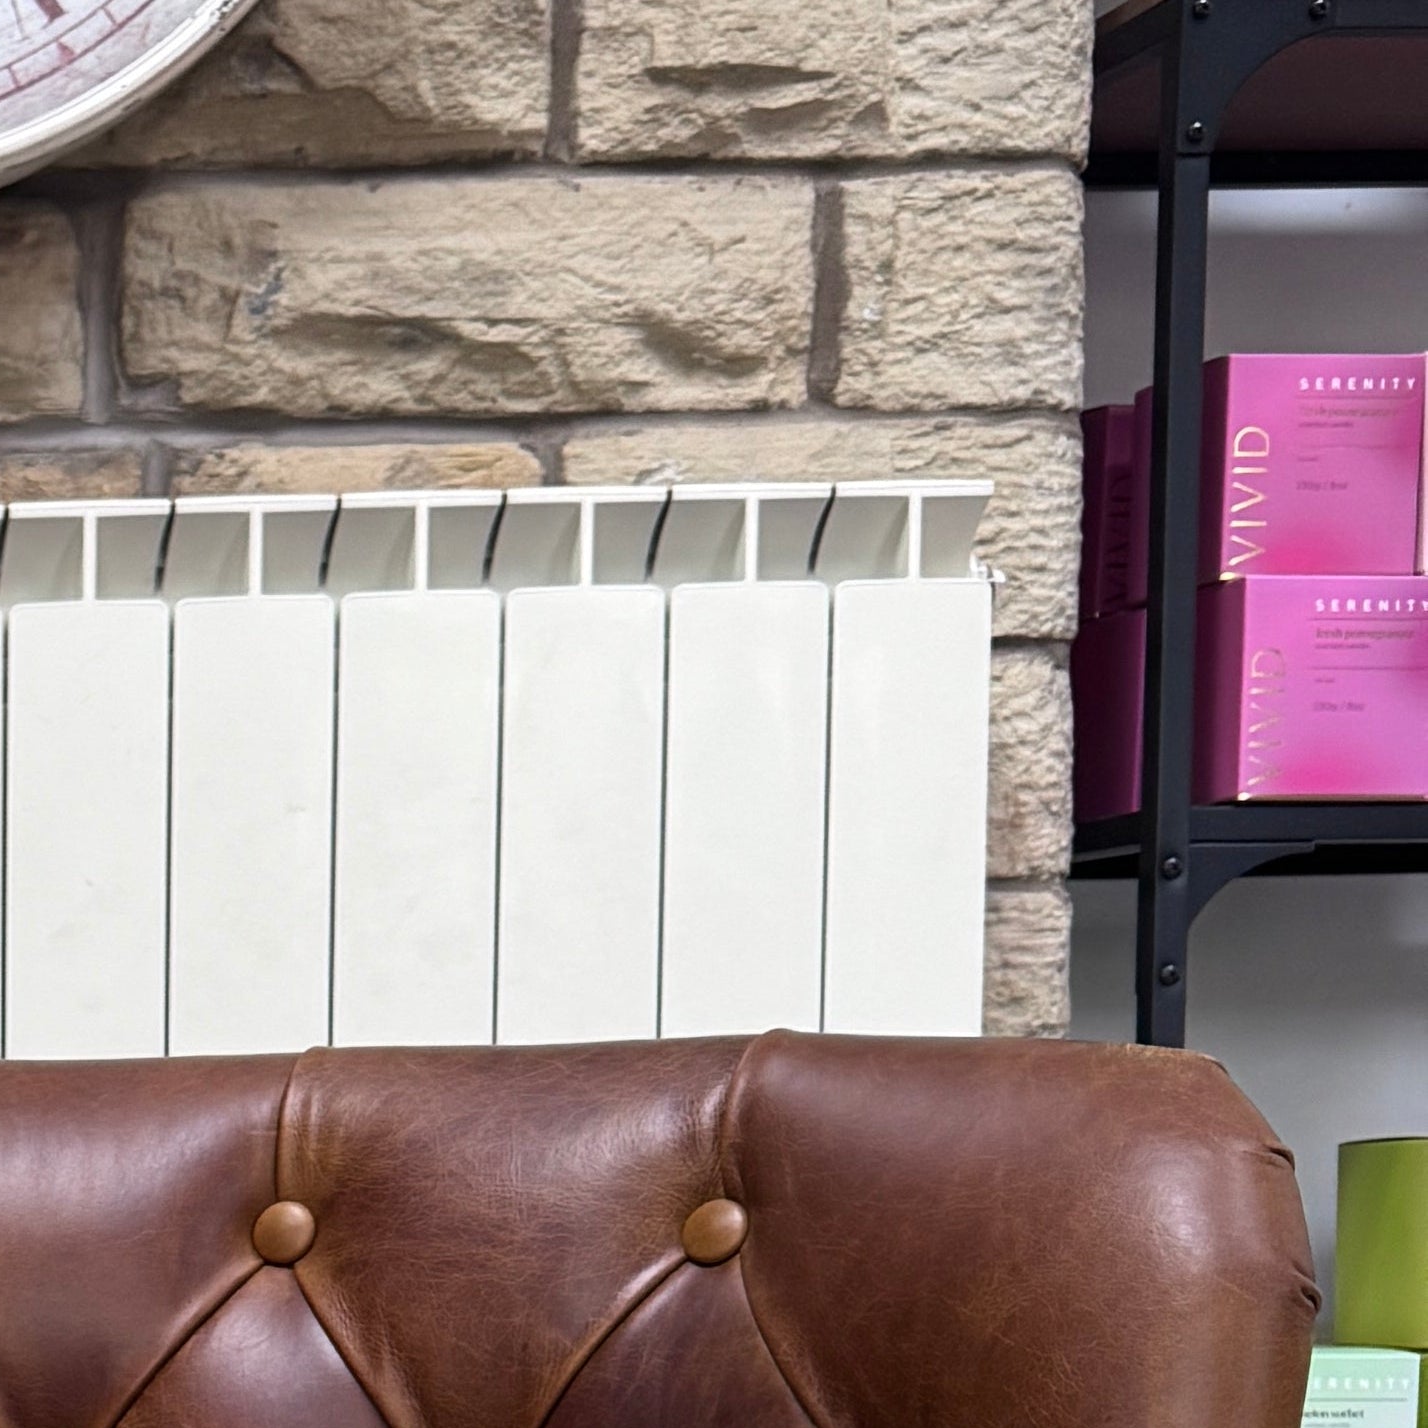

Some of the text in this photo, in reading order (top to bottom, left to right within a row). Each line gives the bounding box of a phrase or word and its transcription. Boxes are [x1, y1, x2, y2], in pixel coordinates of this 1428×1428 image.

[1299, 376, 1416, 391] SERENITY
[1230, 426, 1271, 566] VIVID
[1315, 598, 1428, 613] SERENITY
[1247, 647, 1286, 787] VIVID
[1312, 1376, 1410, 1391] ERENITY
